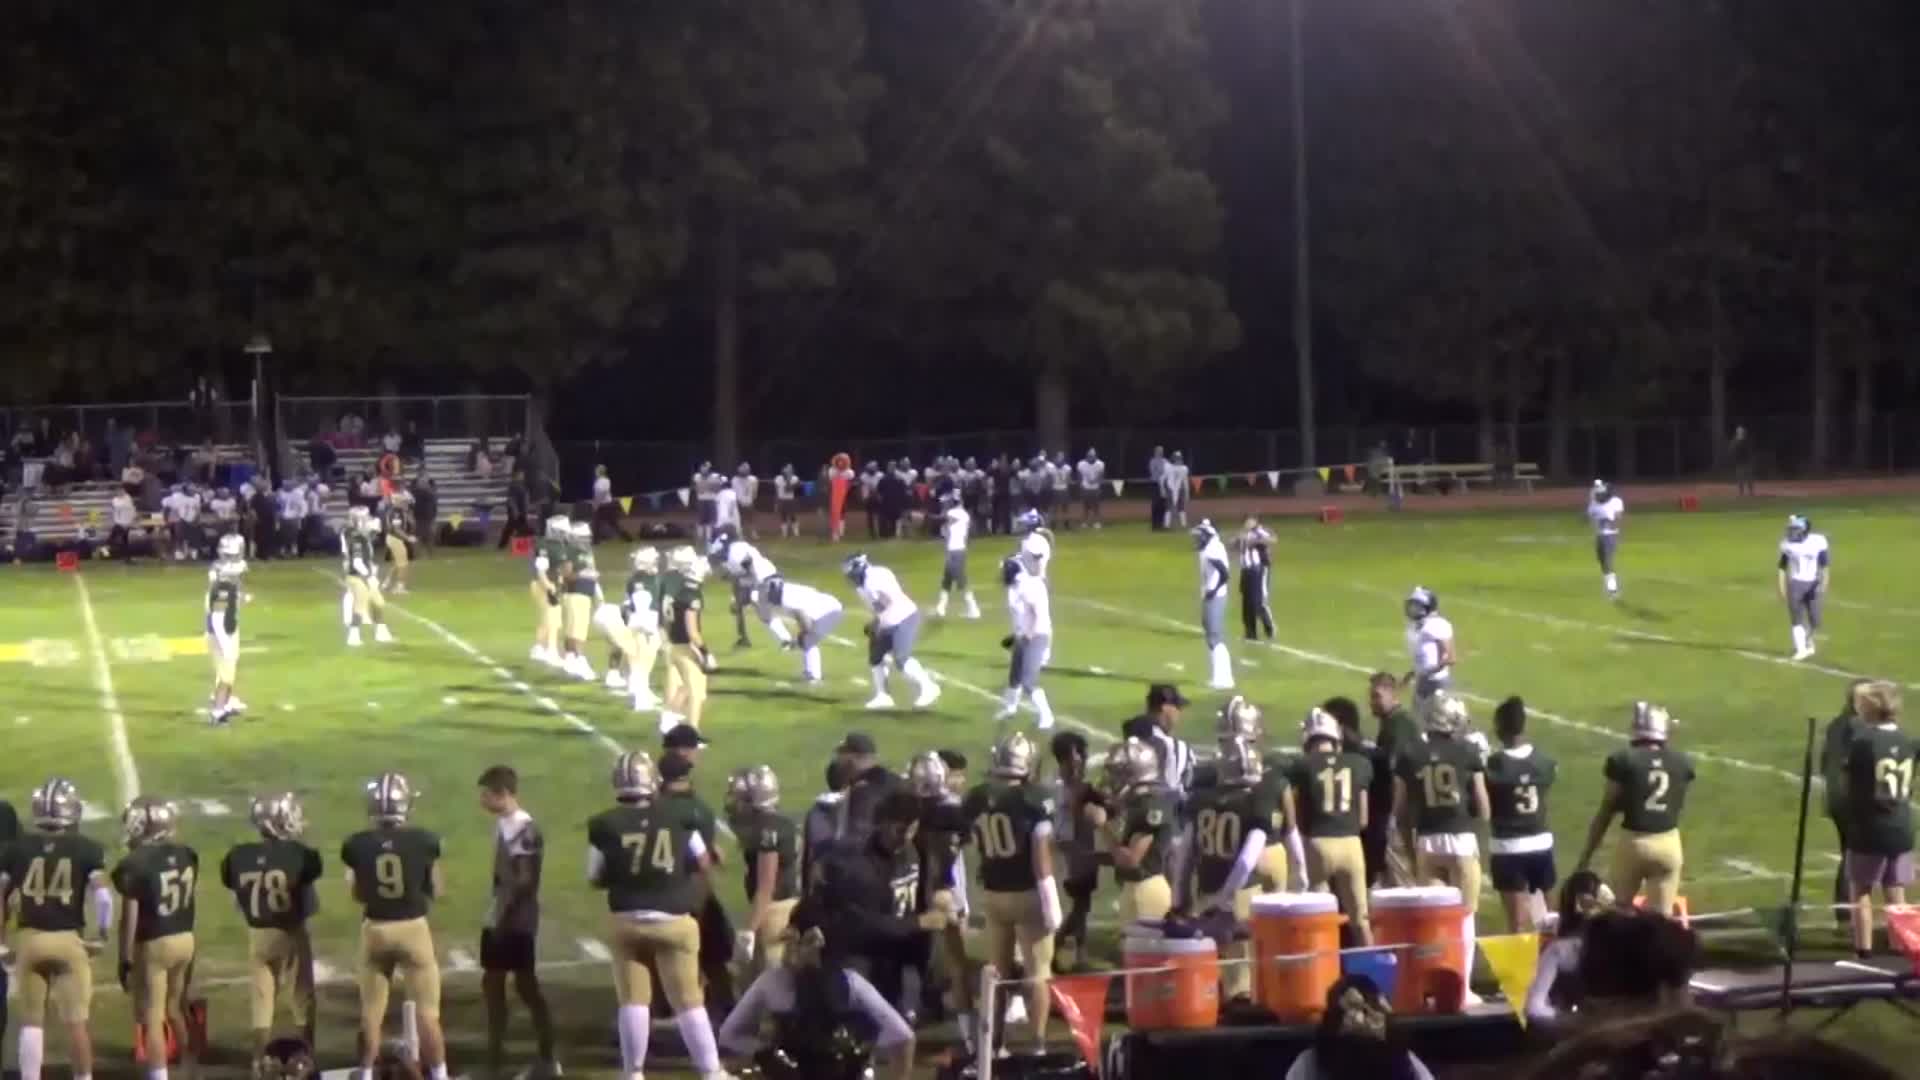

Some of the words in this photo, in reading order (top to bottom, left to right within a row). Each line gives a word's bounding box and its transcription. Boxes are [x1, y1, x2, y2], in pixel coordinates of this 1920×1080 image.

[1317, 767, 1353, 813] 11
[1416, 763, 1461, 808] 19
[1644, 769, 1669, 811] 2
[621, 828, 675, 876] 74
[974, 812, 1017, 860] 10
[1197, 807, 1241, 858] 80
[22, 856, 73, 907] 44
[158, 866, 194, 918] 51
[239, 868, 291, 919] 78
[375, 853, 405, 900] 9
